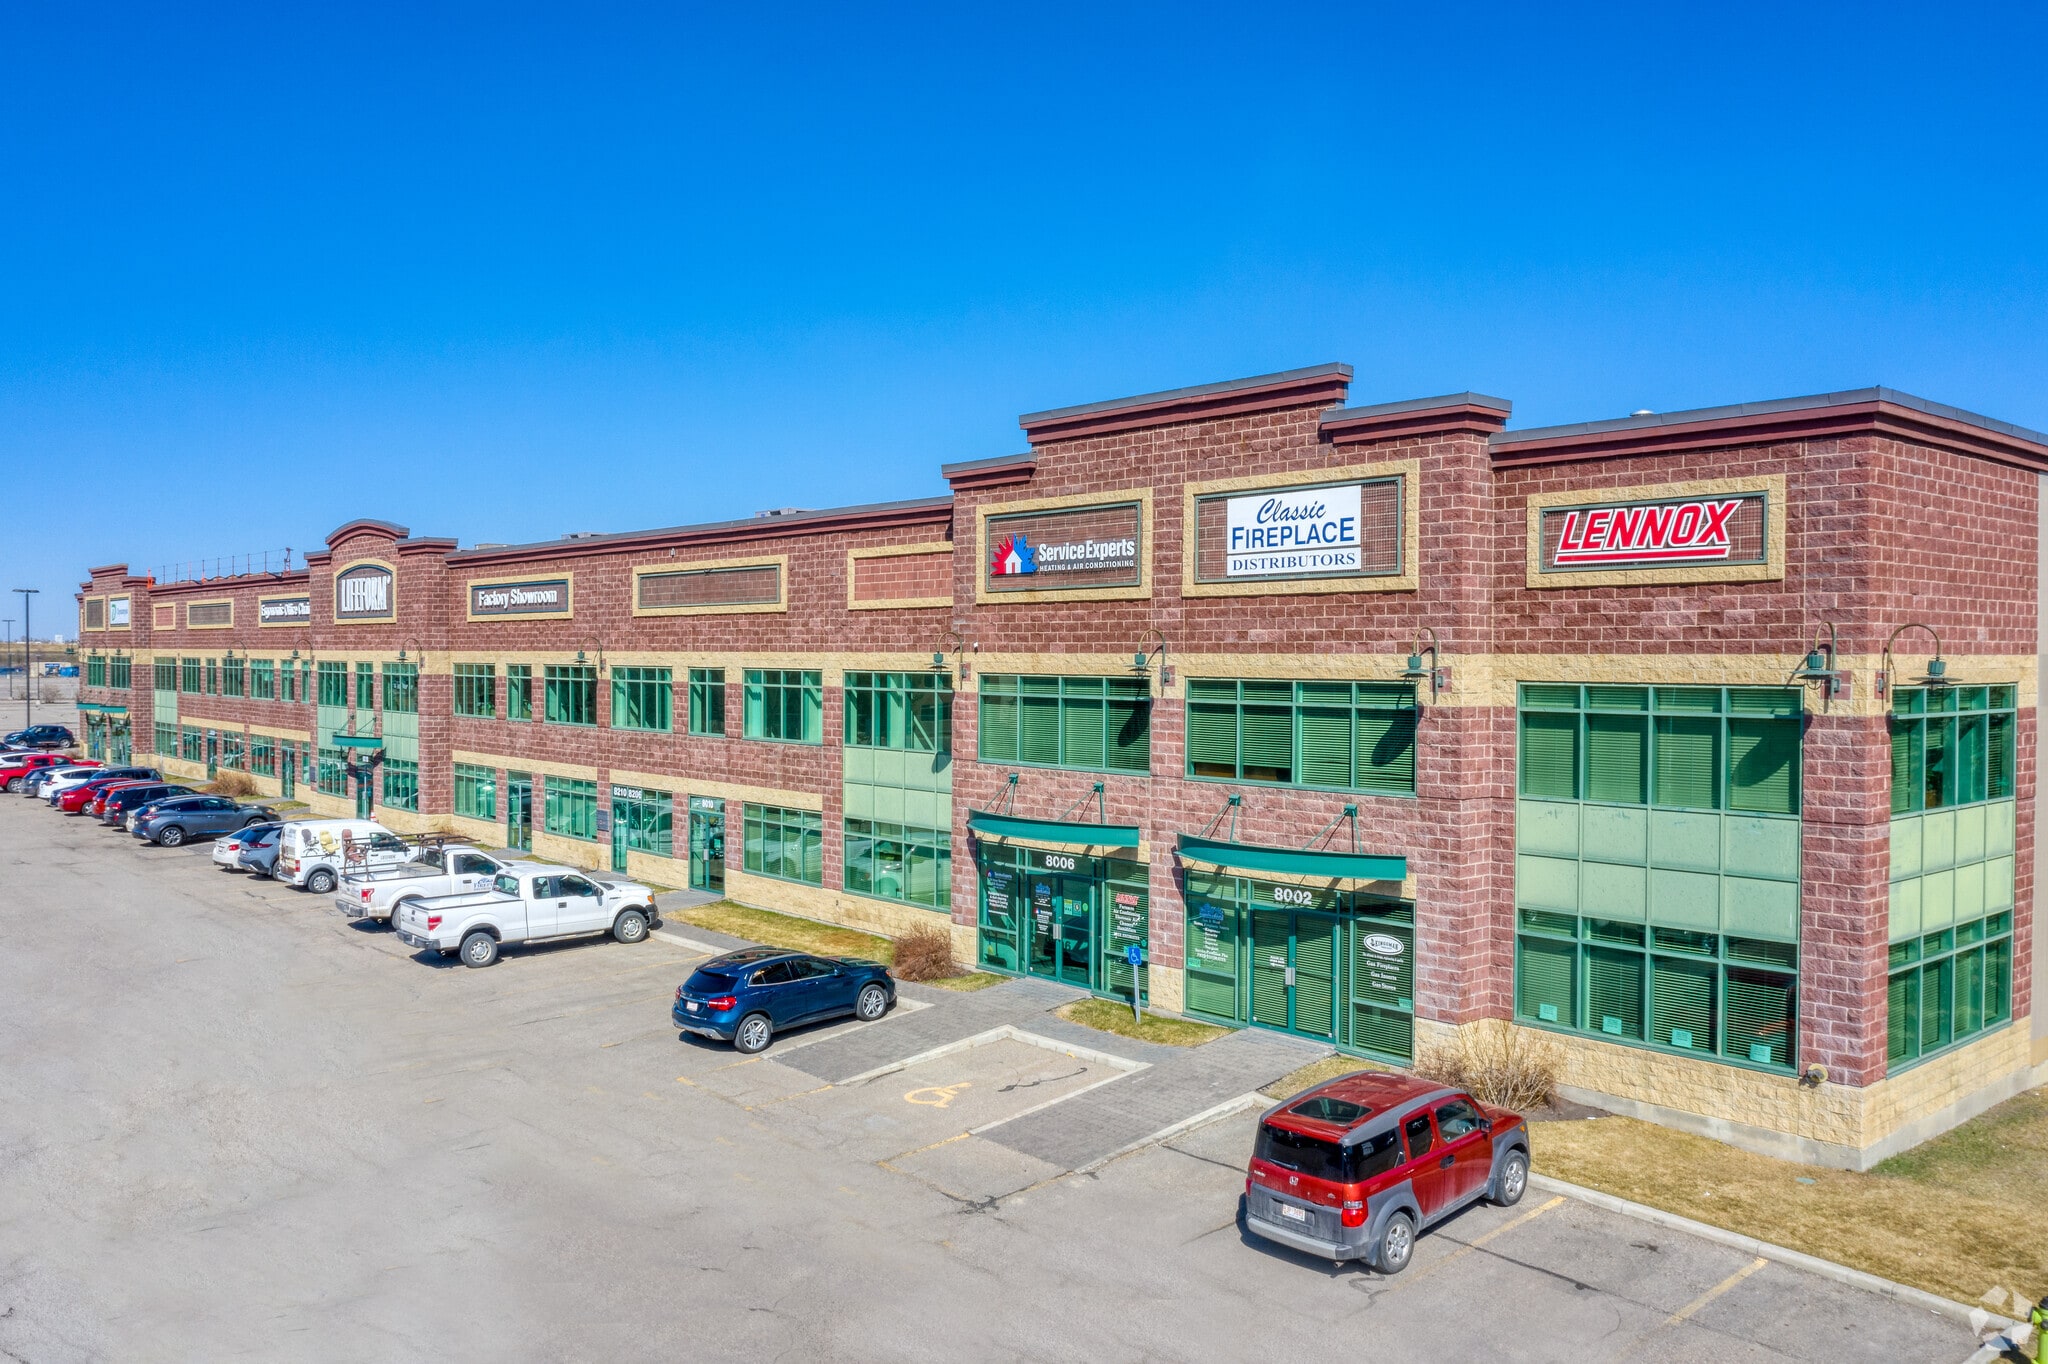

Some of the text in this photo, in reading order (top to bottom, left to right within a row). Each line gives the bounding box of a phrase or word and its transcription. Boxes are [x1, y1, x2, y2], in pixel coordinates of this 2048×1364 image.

[1256, 498, 1326, 524] Classic
[1232, 516, 1355, 550] FIREPLACE
[1557, 499, 1743, 553] LENNOX
[1039, 563, 1066, 572] HEATING
[1072, 562, 1084, 570] AIR
[1086, 560, 1135, 569] CONDITIONING
[1233, 552, 1356, 571] DISTRIBUTORS
[478, 588, 557, 608] Factory Showroom
[613, 786, 628, 797] 8210
[1046, 855, 1075, 870] 8006
[1274, 887, 1312, 905] 8002
